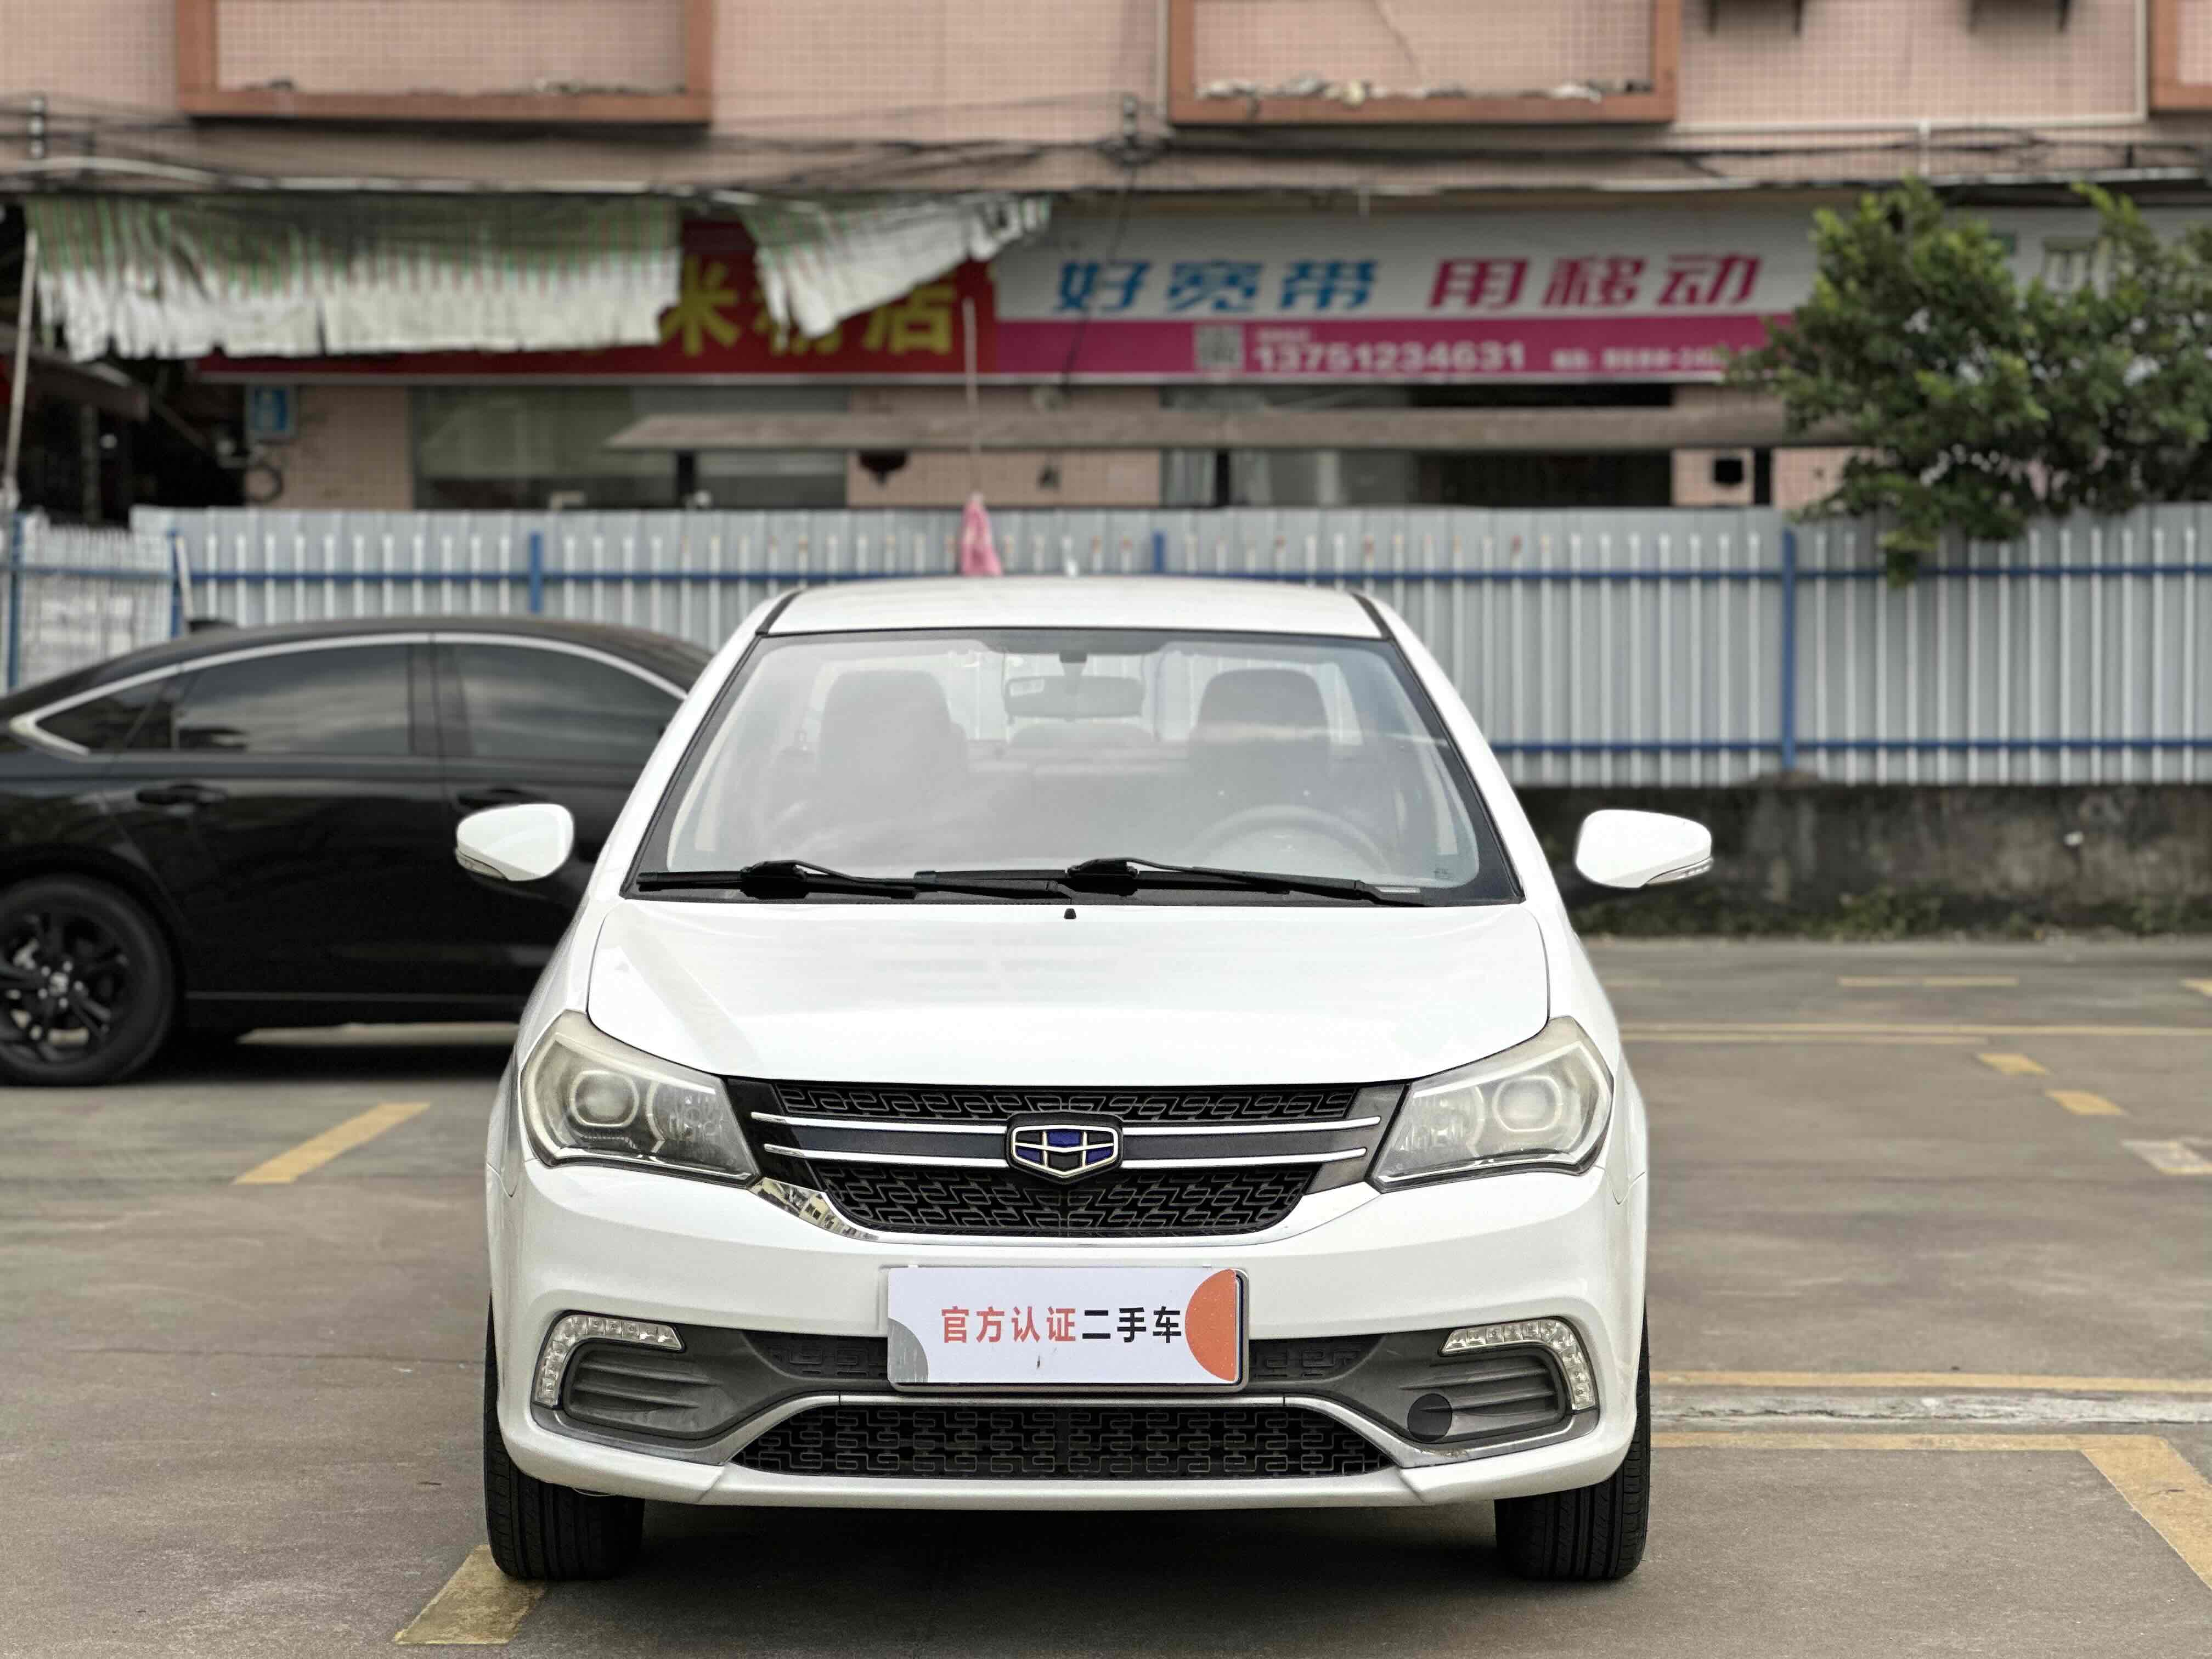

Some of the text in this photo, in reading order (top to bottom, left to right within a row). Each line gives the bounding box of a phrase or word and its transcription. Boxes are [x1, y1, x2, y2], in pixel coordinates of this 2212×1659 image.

[660, 253, 957, 357] 米店
[1053, 253, 1762, 313] 好宽带 用移动
[941, 1306, 1182, 1344] 官方认证二手车
